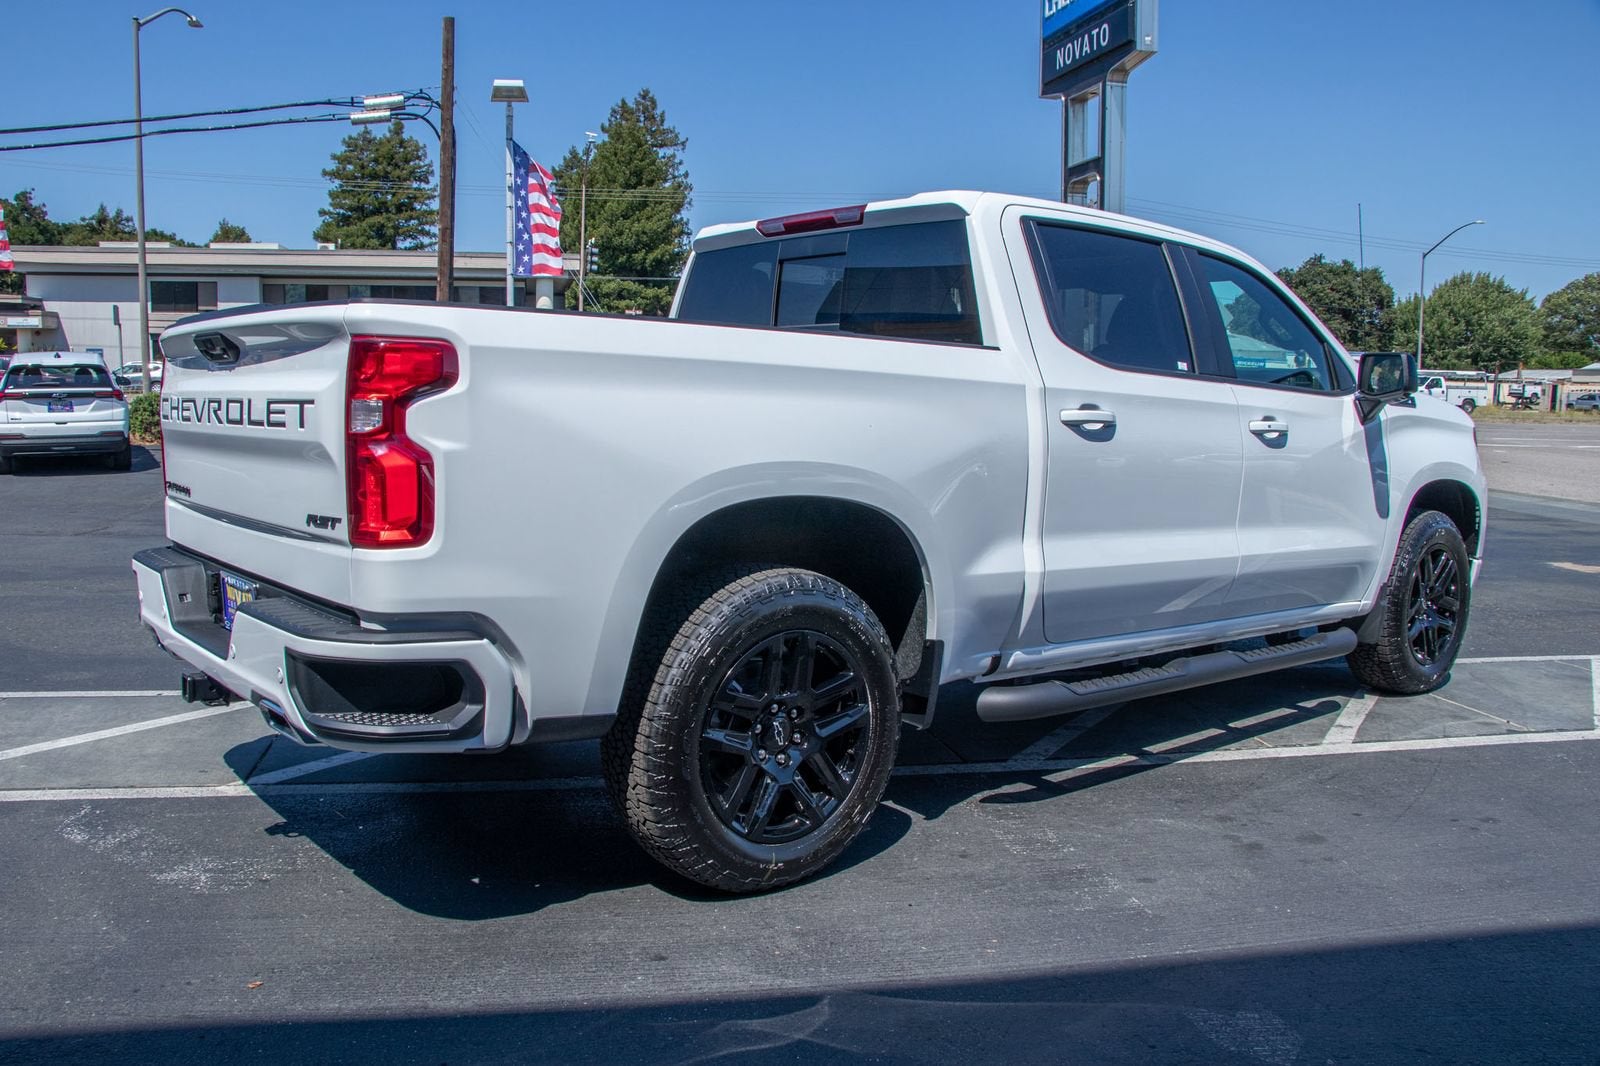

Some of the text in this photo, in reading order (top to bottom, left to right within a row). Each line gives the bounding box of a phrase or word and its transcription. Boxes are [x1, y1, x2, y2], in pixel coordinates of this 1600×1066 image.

[1056, 23, 1109, 70] NOVATO
[161, 398, 315, 430] CHEVROLET
[306, 513, 342, 531] RST
